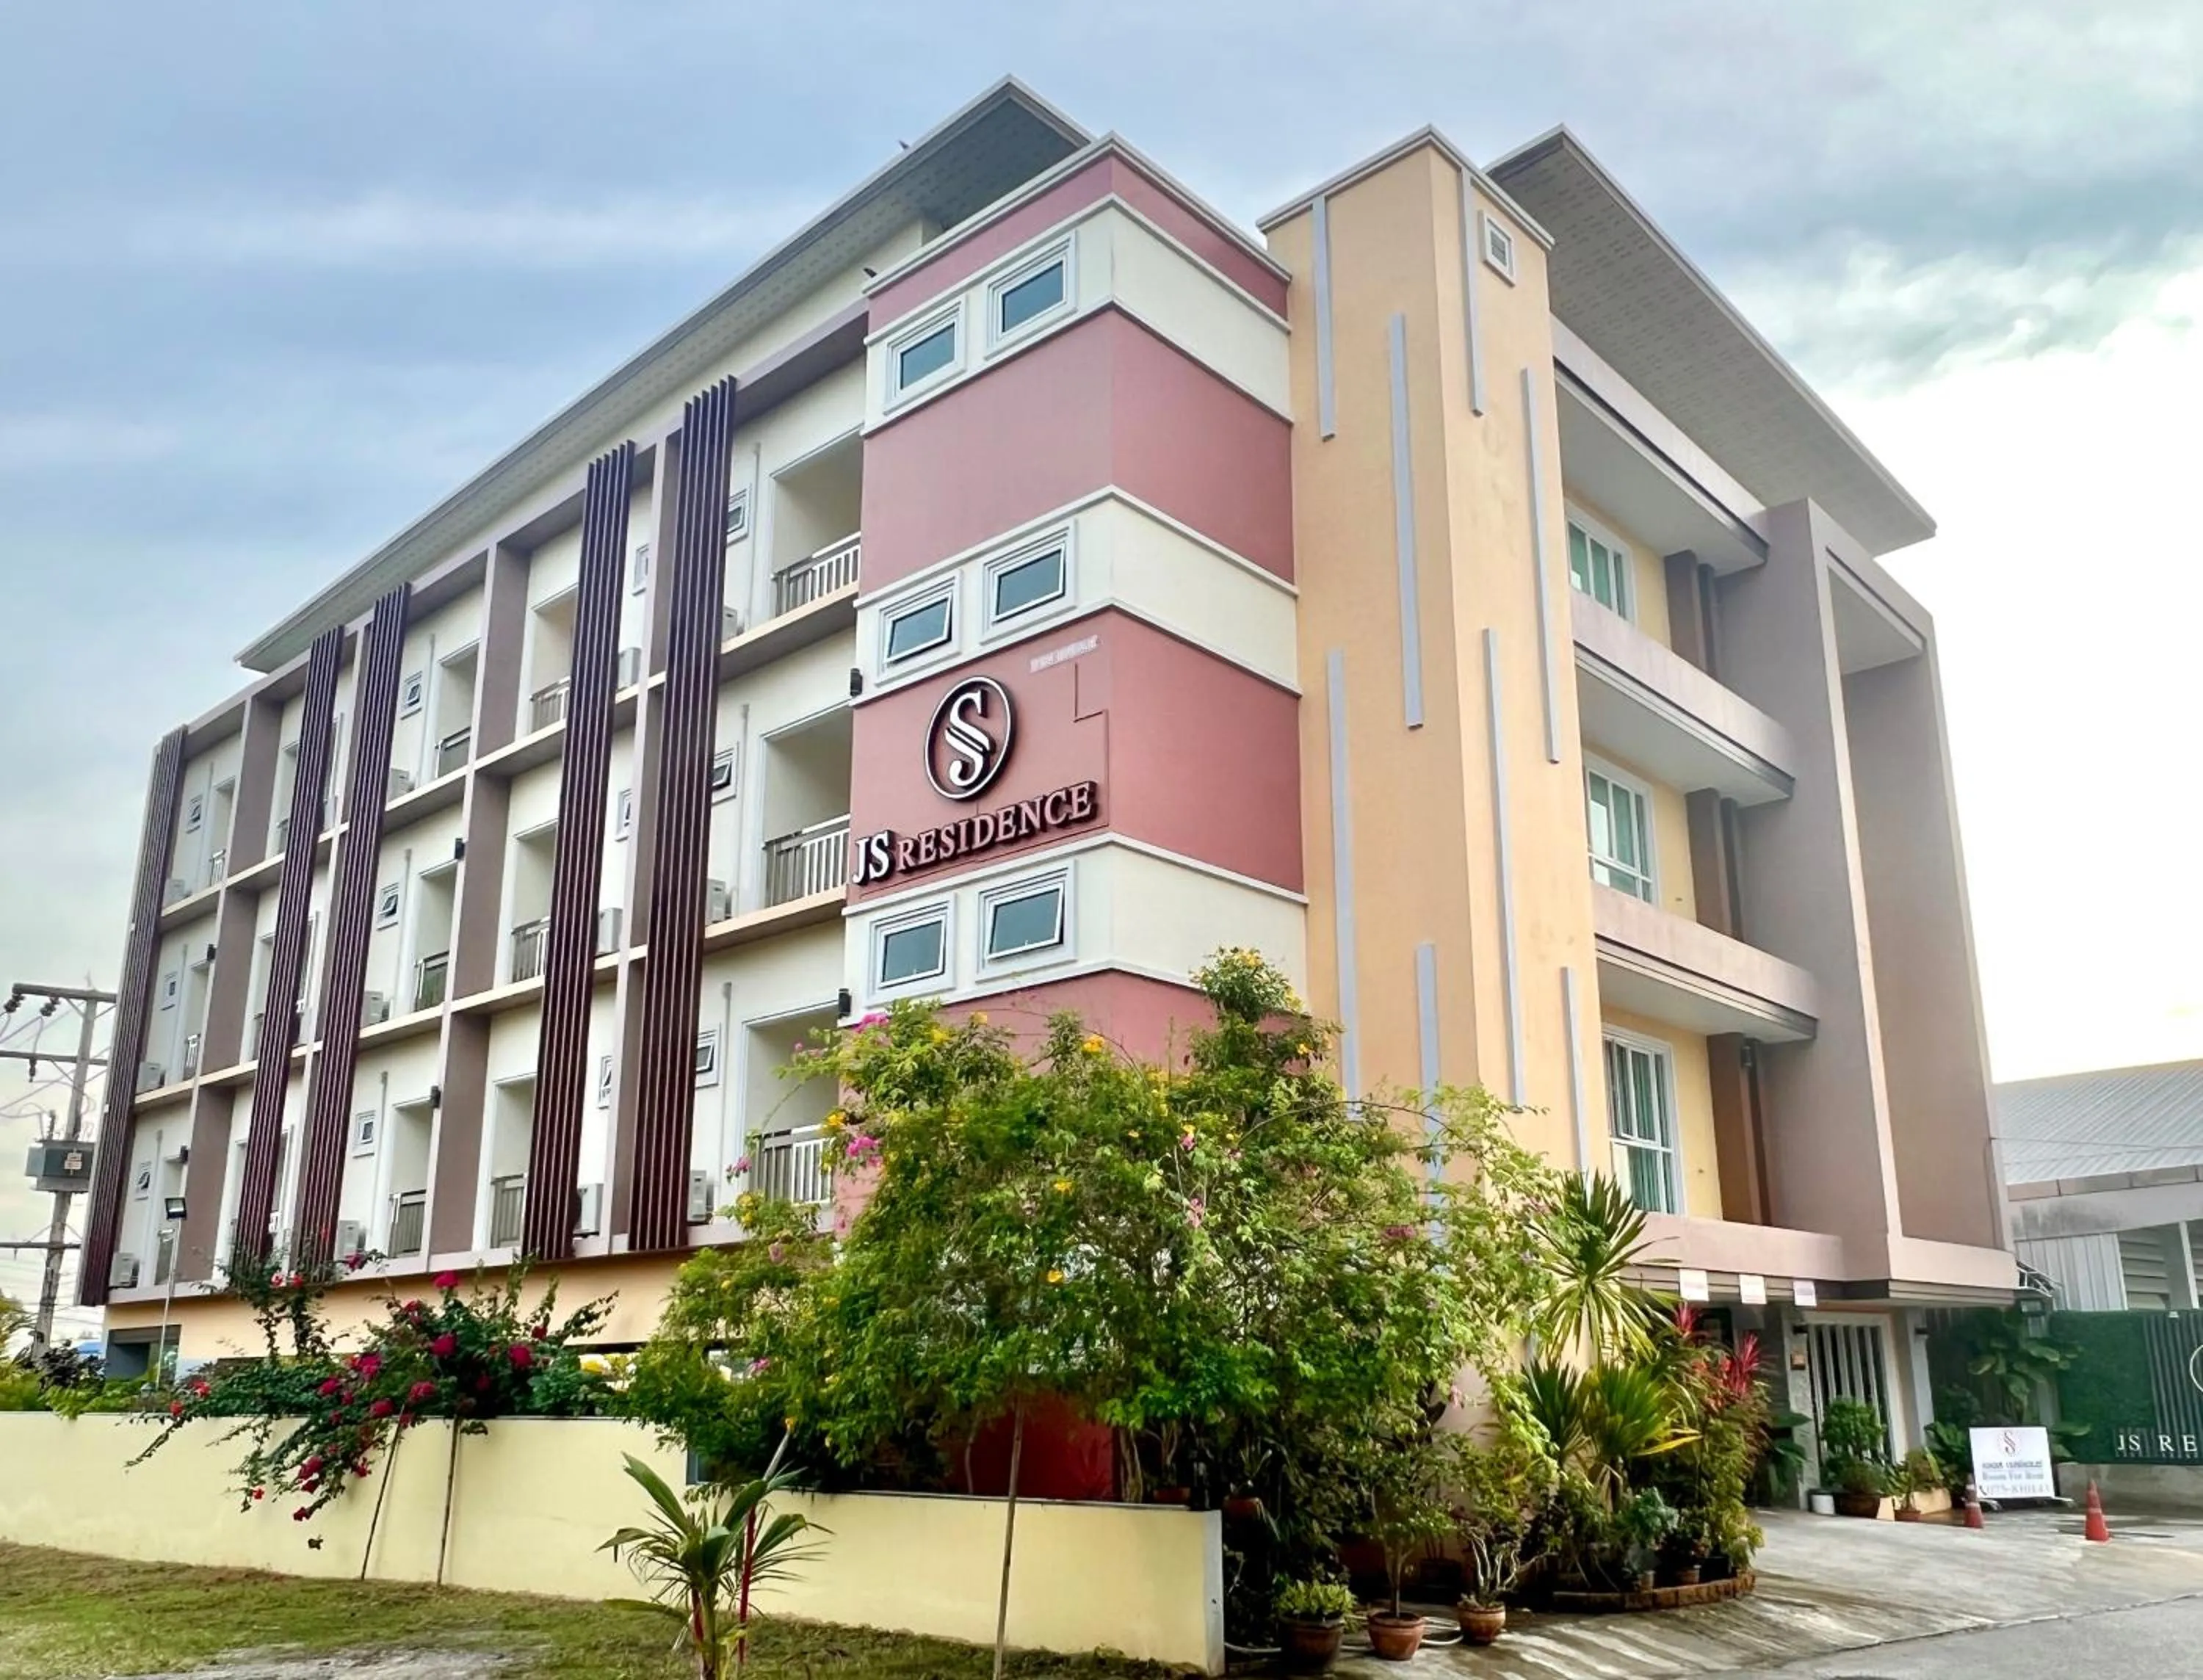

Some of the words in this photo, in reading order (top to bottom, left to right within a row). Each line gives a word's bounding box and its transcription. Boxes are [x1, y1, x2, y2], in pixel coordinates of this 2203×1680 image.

[852, 830, 890, 884] JS
[896, 782, 1095, 872] RESIDENCE
[2117, 1434, 2141, 1452] JS
